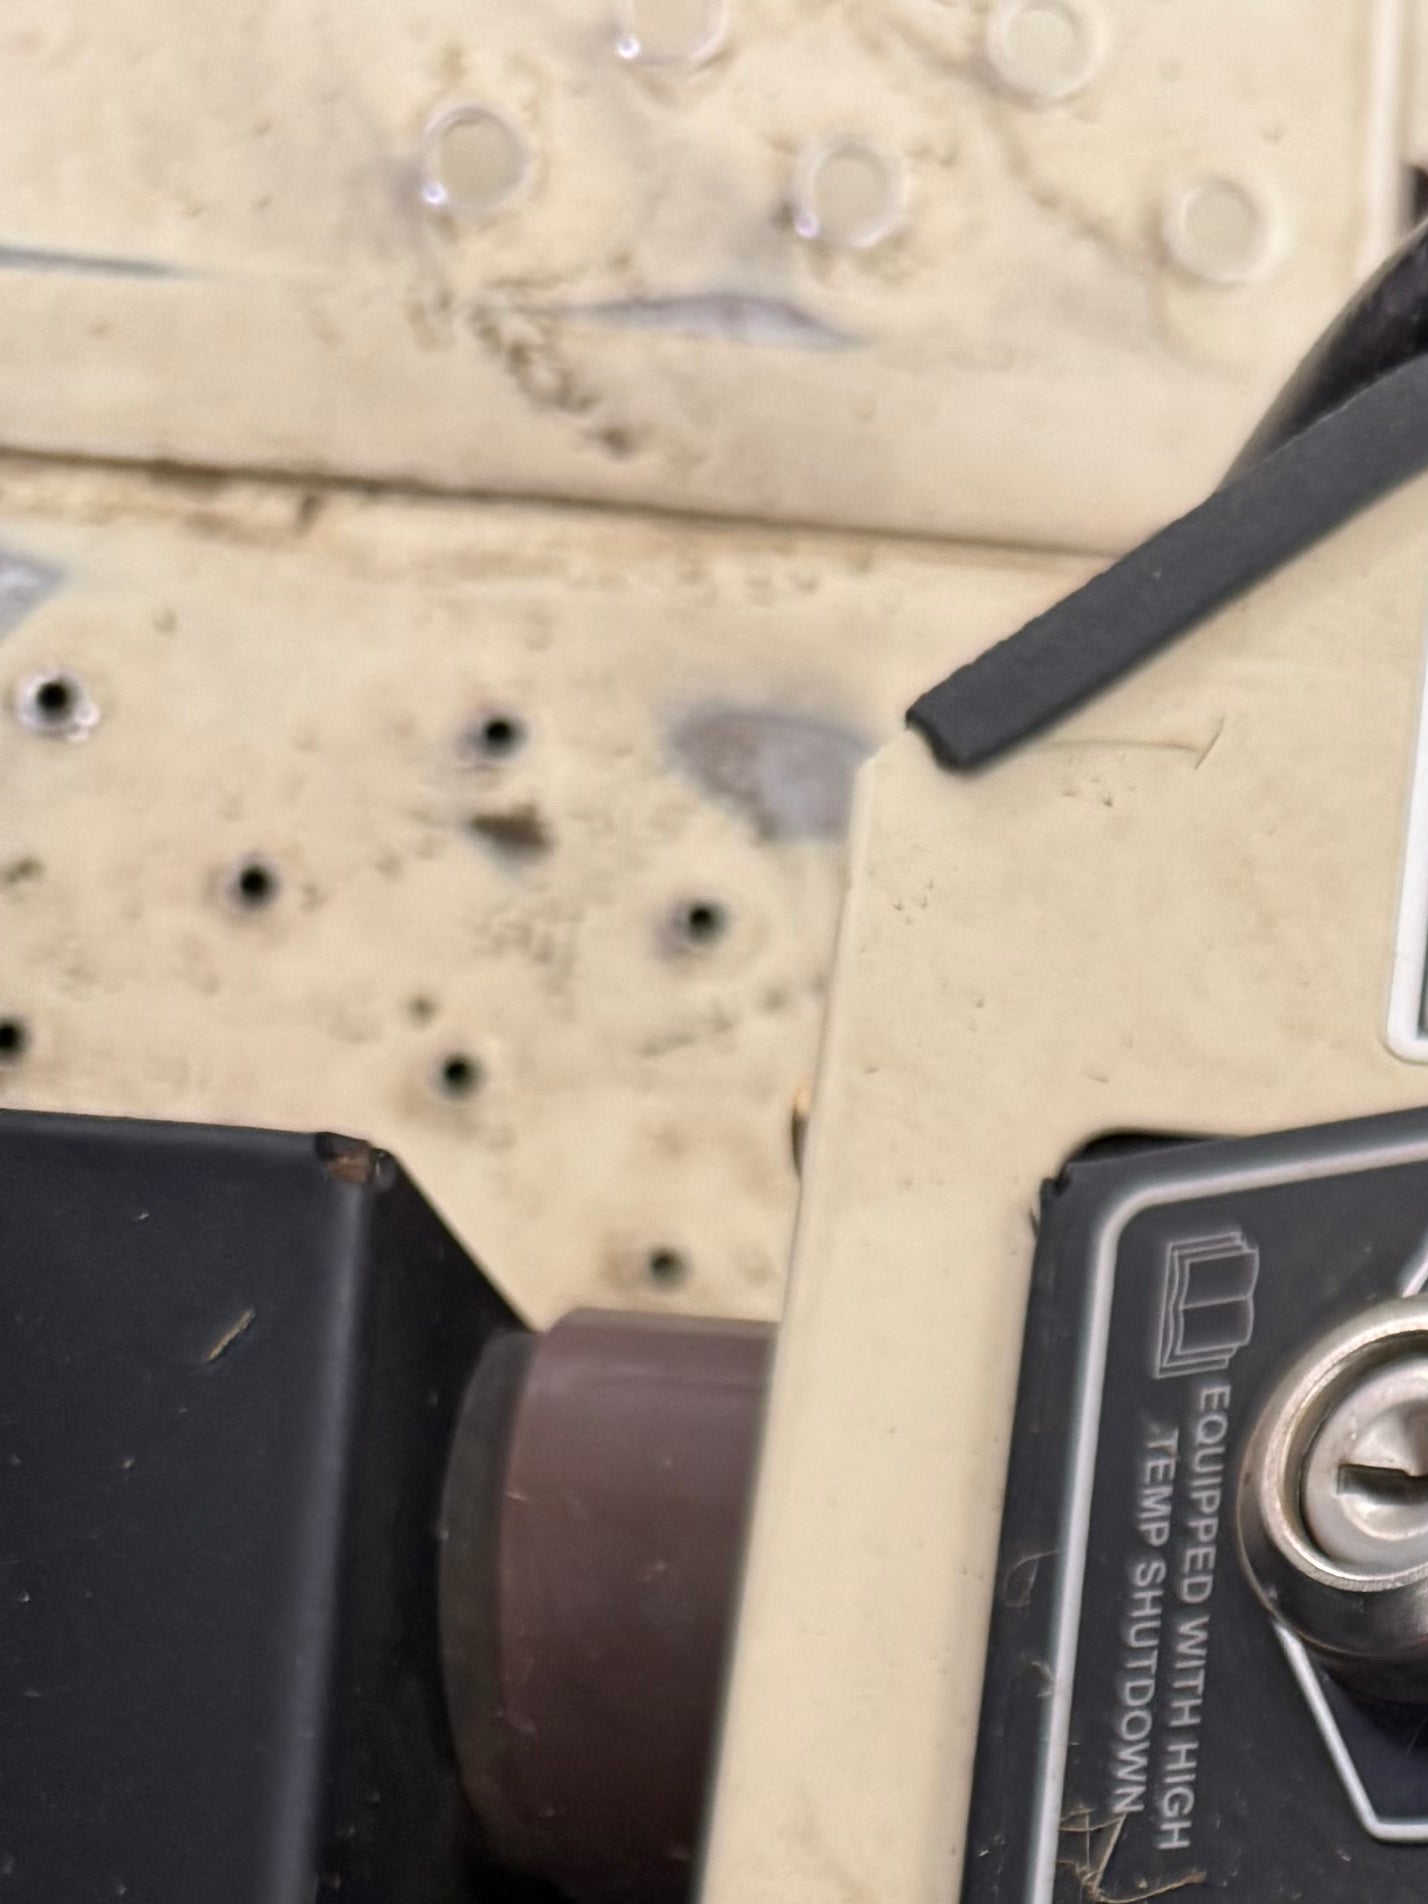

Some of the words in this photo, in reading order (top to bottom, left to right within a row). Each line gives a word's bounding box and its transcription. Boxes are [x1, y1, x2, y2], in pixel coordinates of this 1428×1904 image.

[1135, 1428, 1178, 1546] TEMP
[1181, 1384, 1231, 1605] EQUIPPED
[1110, 1562, 1168, 1814] SHUTDOWN
[1172, 1614, 1210, 1731] WITH
[1157, 1746, 1197, 1851] HIGH
